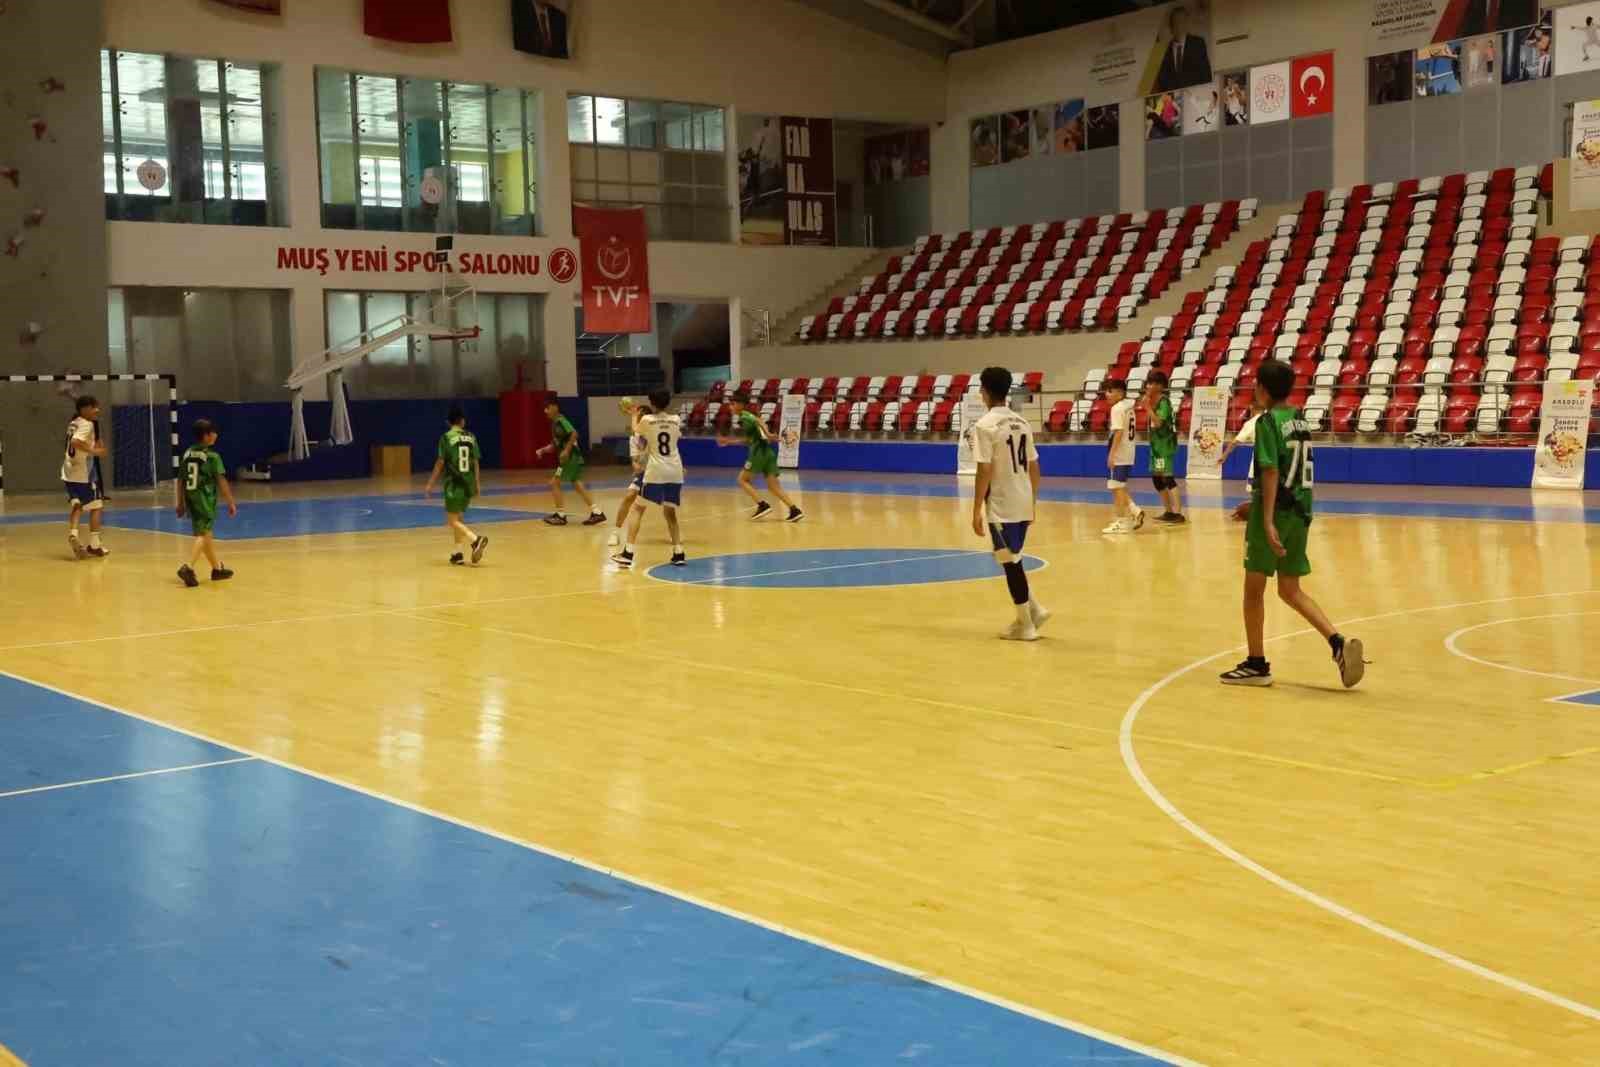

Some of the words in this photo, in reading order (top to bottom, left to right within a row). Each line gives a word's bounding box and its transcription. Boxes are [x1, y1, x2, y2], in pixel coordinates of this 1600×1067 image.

[277, 247, 330, 276] MUŞ
[334, 244, 388, 272] YENİ
[458, 252, 540, 275] SALONU
[592, 285, 639, 308] TVF
[657, 431, 671, 457] 8
[1006, 433, 1028, 474] 14
[458, 446, 471, 473] 8
[1284, 439, 1314, 489] 76
[186, 461, 200, 491] 3
